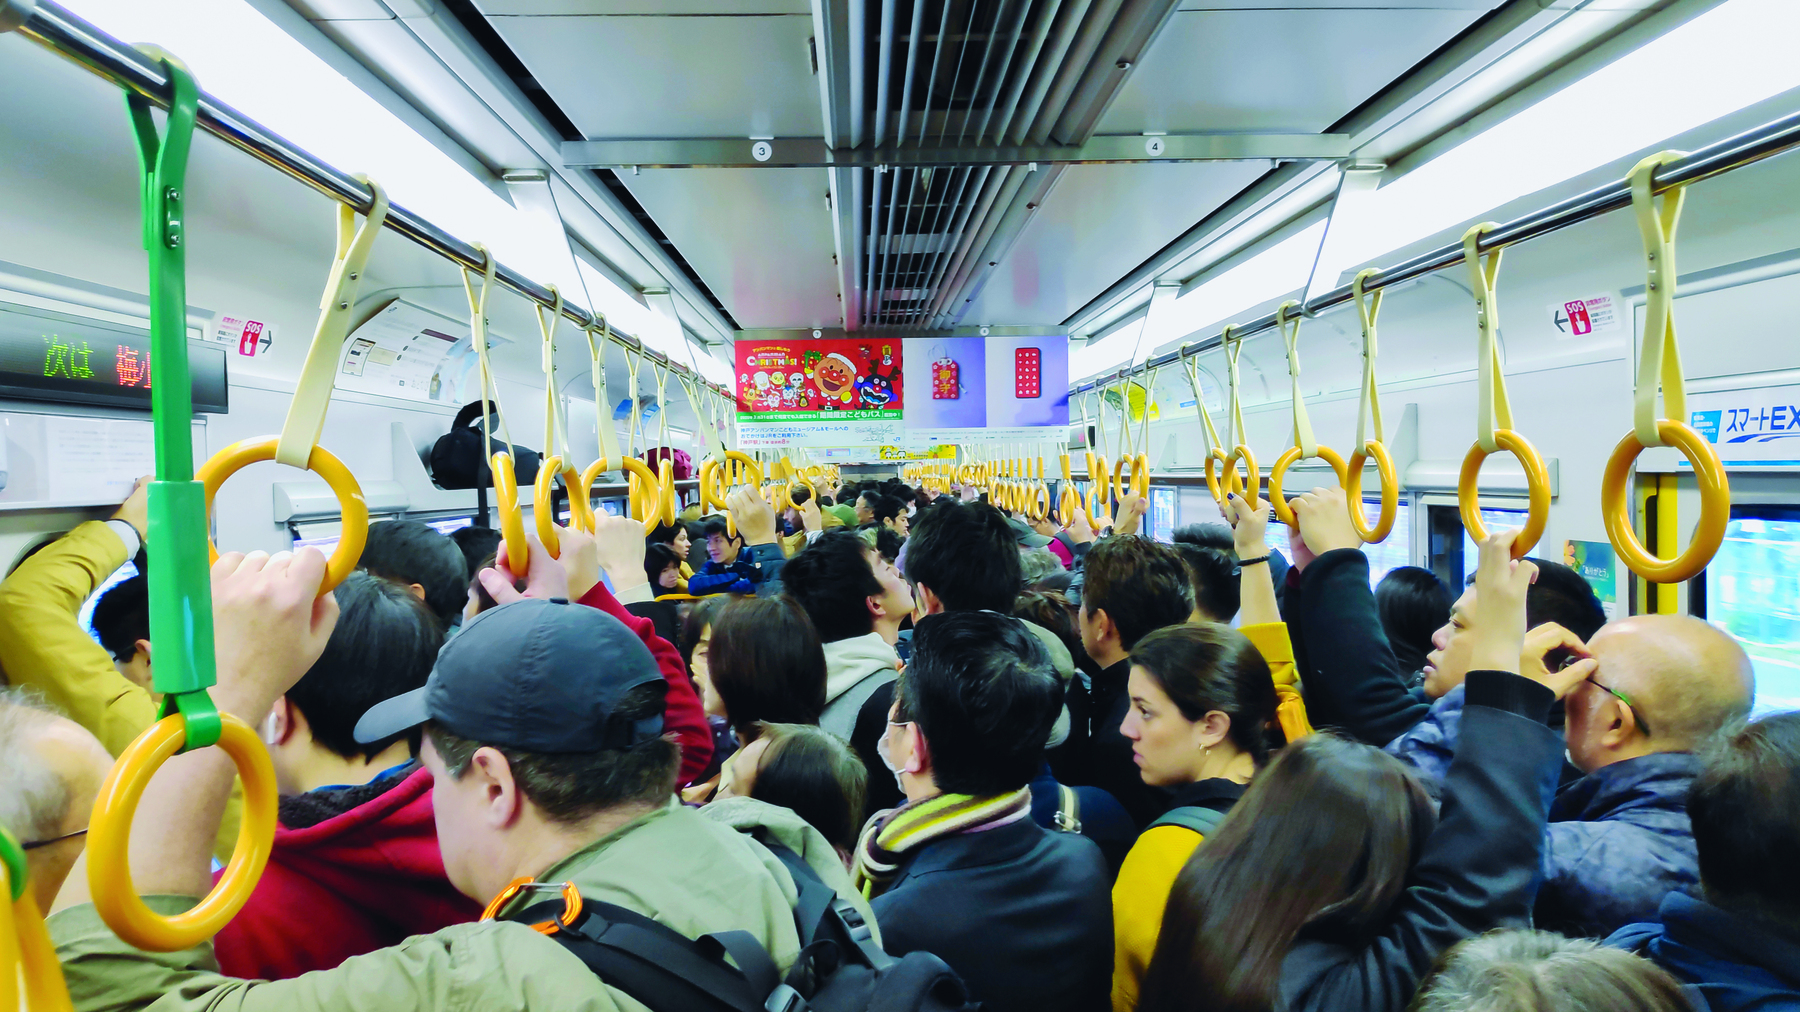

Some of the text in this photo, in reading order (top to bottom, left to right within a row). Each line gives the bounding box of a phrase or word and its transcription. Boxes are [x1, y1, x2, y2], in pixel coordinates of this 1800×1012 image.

[759, 147, 765, 156] 3
[1152, 142, 1158, 151] 4
[1566, 301, 1584, 314] SOS
[245, 322, 261, 334] SOS
[42, 334, 95, 379] 次は
[1726, 405, 1800, 433] スマートEX
